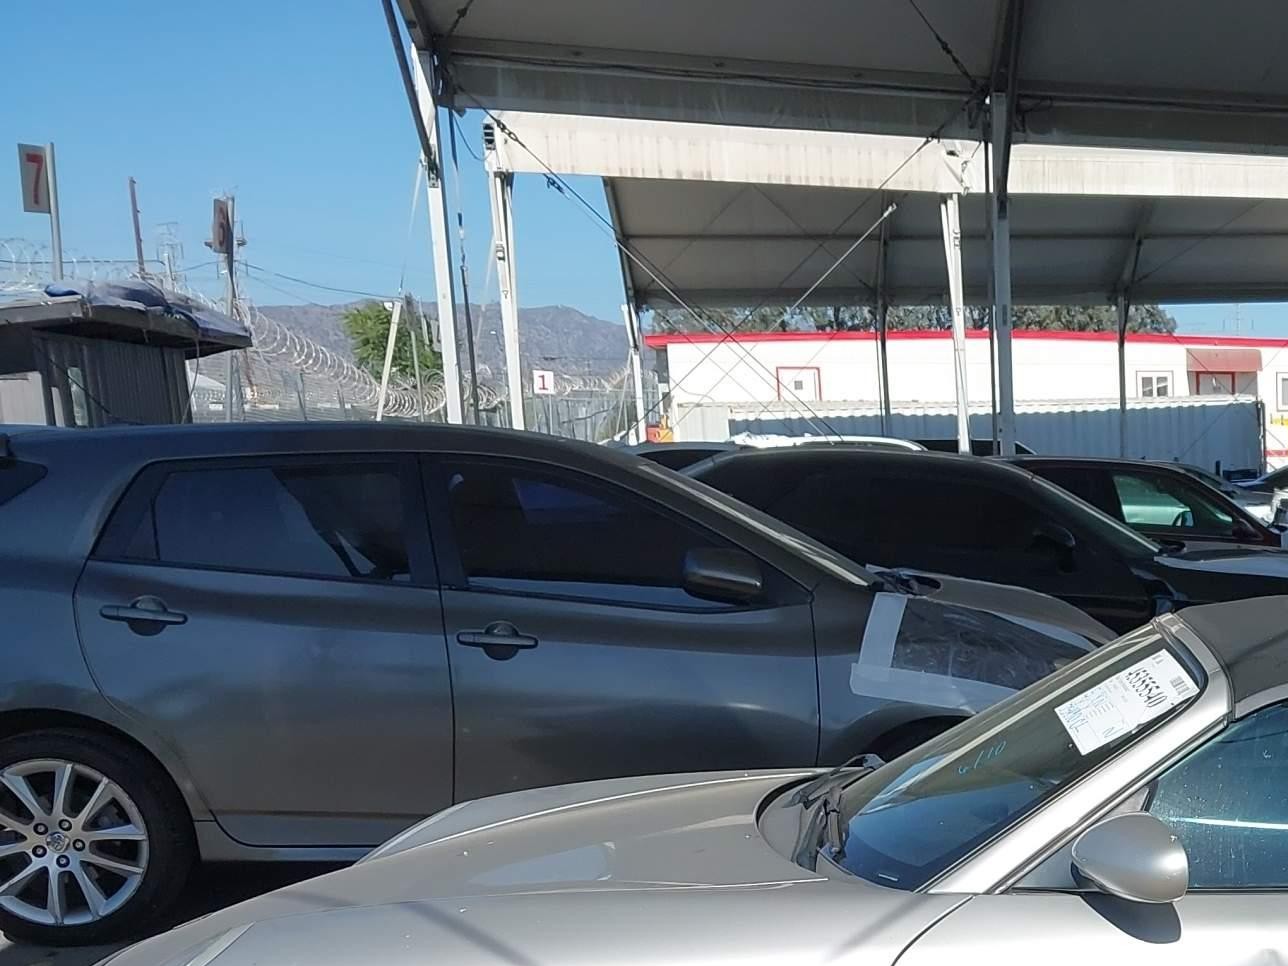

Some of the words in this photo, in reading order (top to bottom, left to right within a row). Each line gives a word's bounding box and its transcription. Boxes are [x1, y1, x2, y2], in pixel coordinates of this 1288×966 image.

[25, 152, 44, 205] 7
[538, 375, 549, 390] 1
[1125, 667, 1168, 708] 45355540
